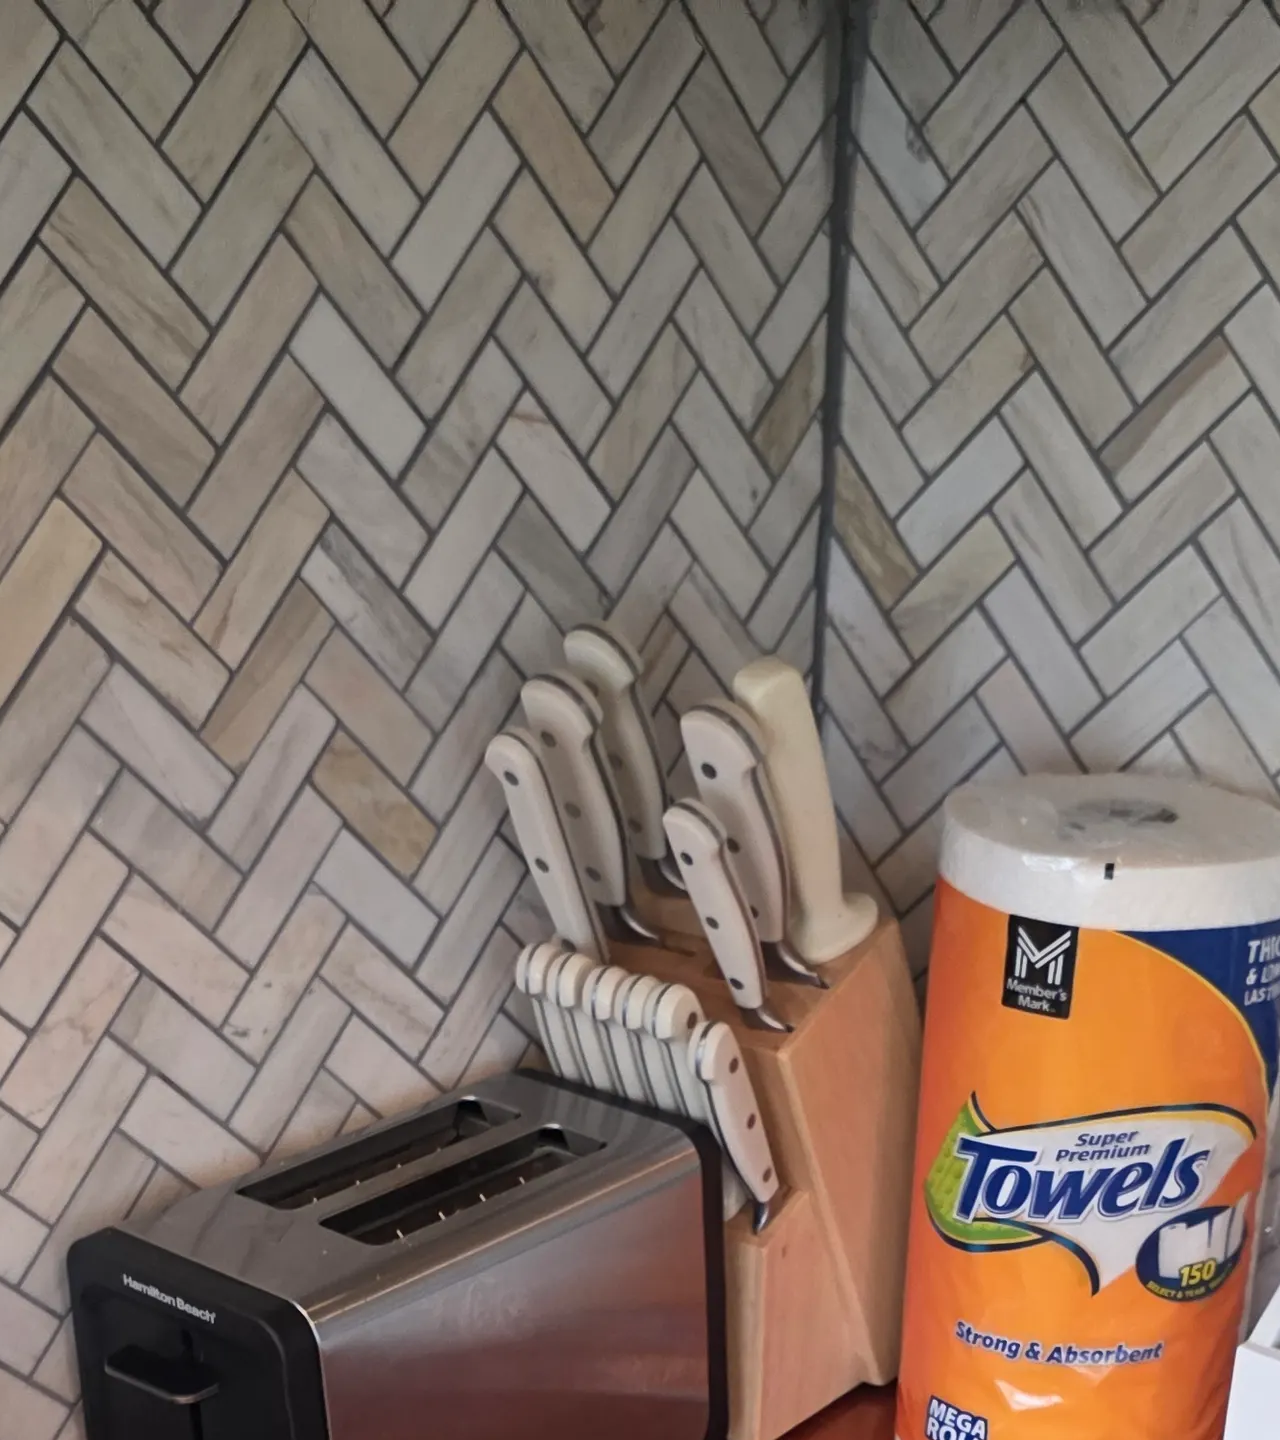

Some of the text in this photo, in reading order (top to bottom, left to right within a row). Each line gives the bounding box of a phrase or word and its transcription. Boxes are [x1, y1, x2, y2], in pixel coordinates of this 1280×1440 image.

[1245, 967, 1258, 986] &
[1006, 978, 1068, 1002] Member's
[1018, 995, 1051, 1012] Mark
[1055, 1142, 1151, 1163] Premium
[1075, 1131, 1140, 1149] Super
[953, 1137, 1210, 1222] Towels
[1179, 1258, 1217, 1287] 150
[122, 1273, 216, 1325] Hamilton Beach
[955, 1321, 1164, 1365] Strong & Absorbent
[929, 1399, 987, 1440] MEGA
